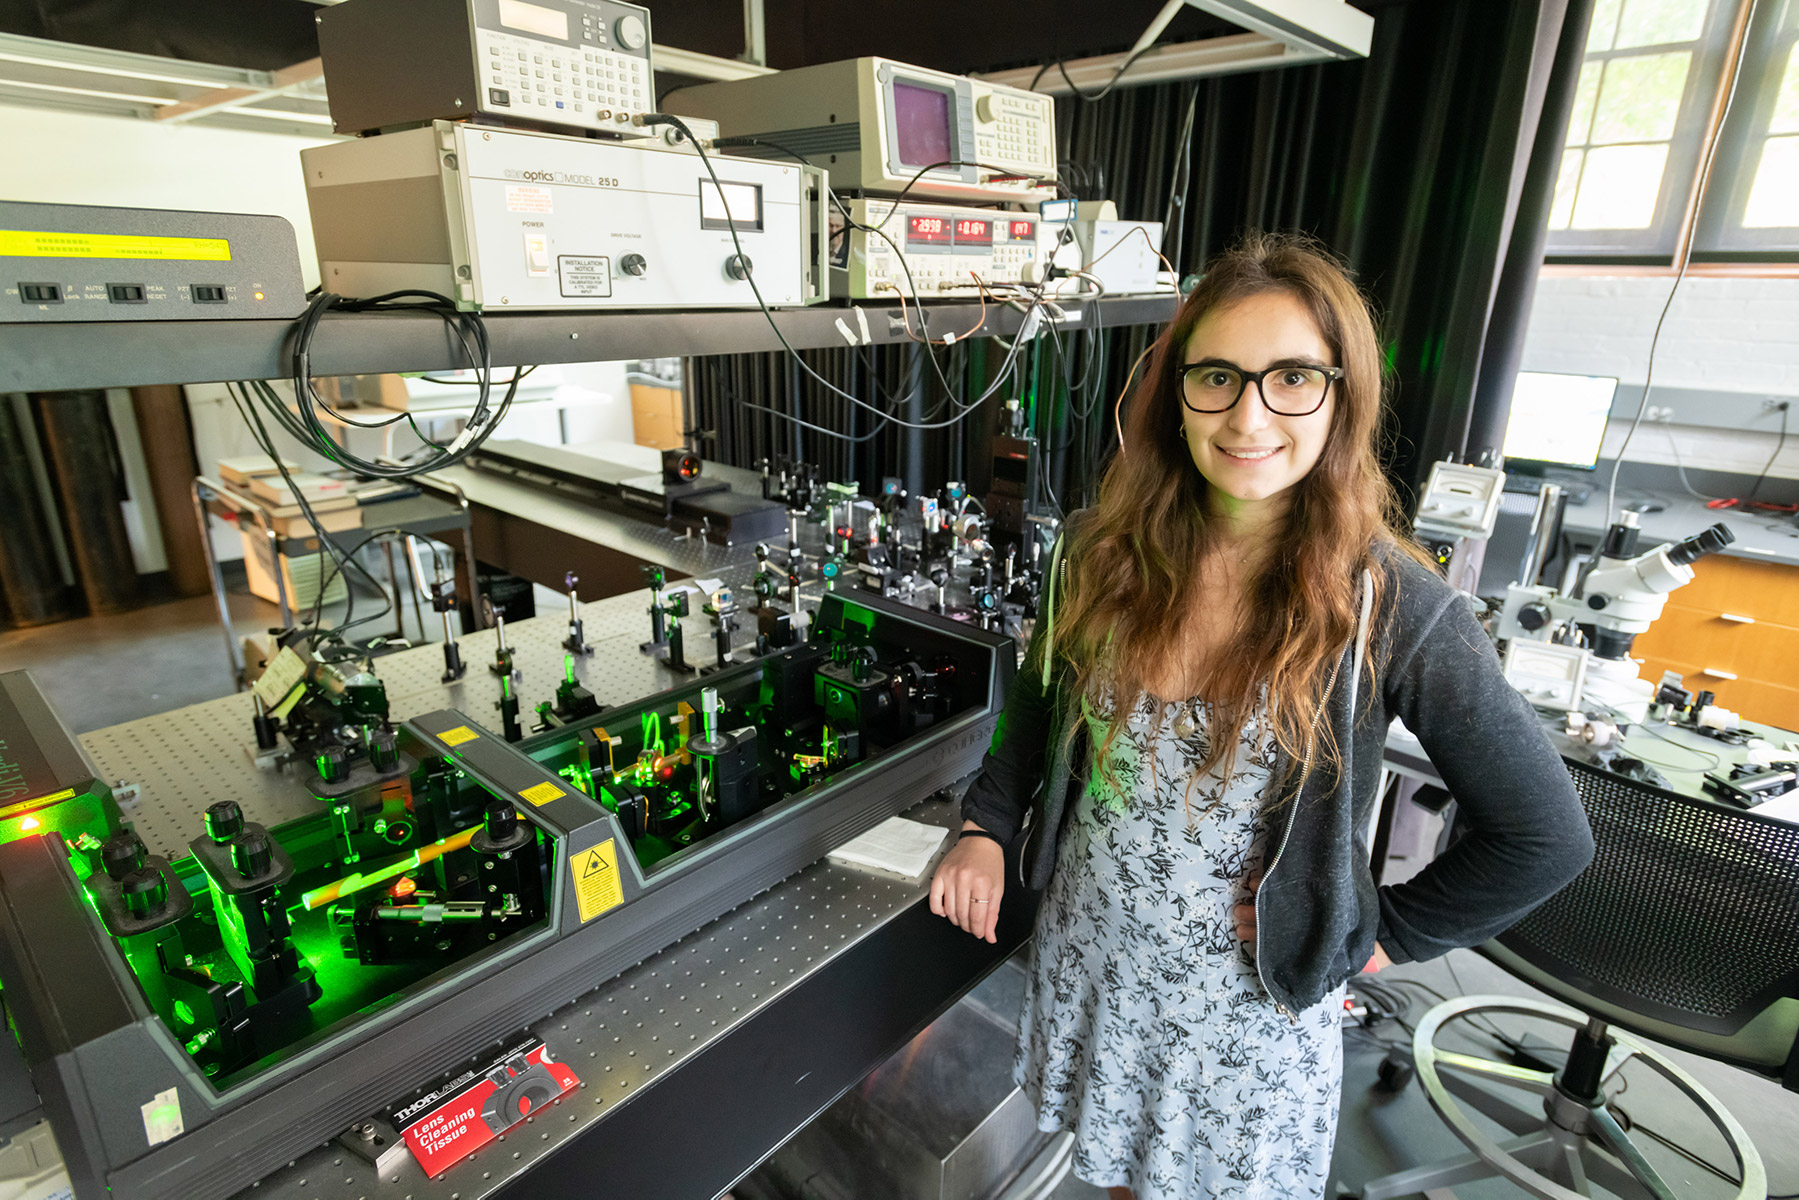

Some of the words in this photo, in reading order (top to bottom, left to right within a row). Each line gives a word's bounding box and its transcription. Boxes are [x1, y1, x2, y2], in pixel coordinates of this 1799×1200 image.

[564, 174, 596, 185] MODEL
[413, 1114, 445, 1139] Lens
[419, 1107, 476, 1148] Cleaning
[424, 1124, 468, 1156] Tissue
